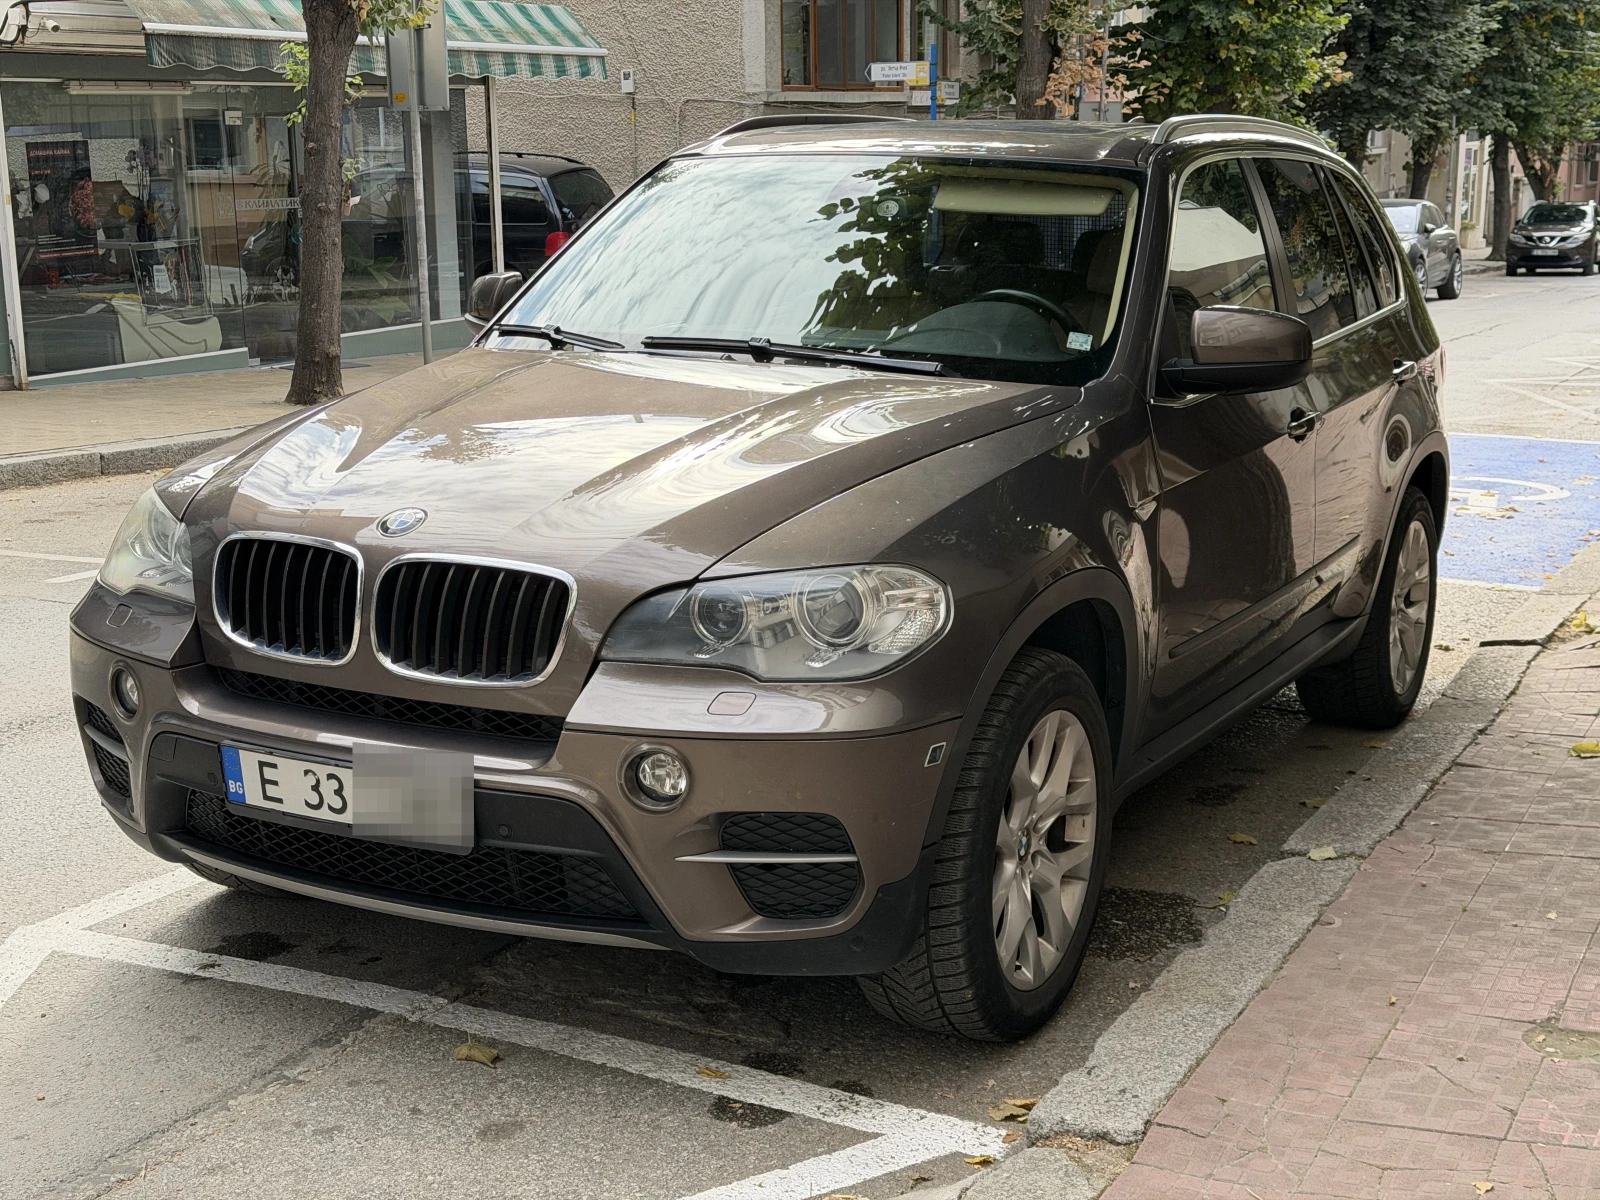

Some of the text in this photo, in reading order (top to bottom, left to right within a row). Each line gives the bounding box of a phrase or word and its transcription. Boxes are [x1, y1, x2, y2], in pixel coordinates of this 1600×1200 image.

[228, 779, 244, 794] BG
[257, 759, 348, 815] E 33
